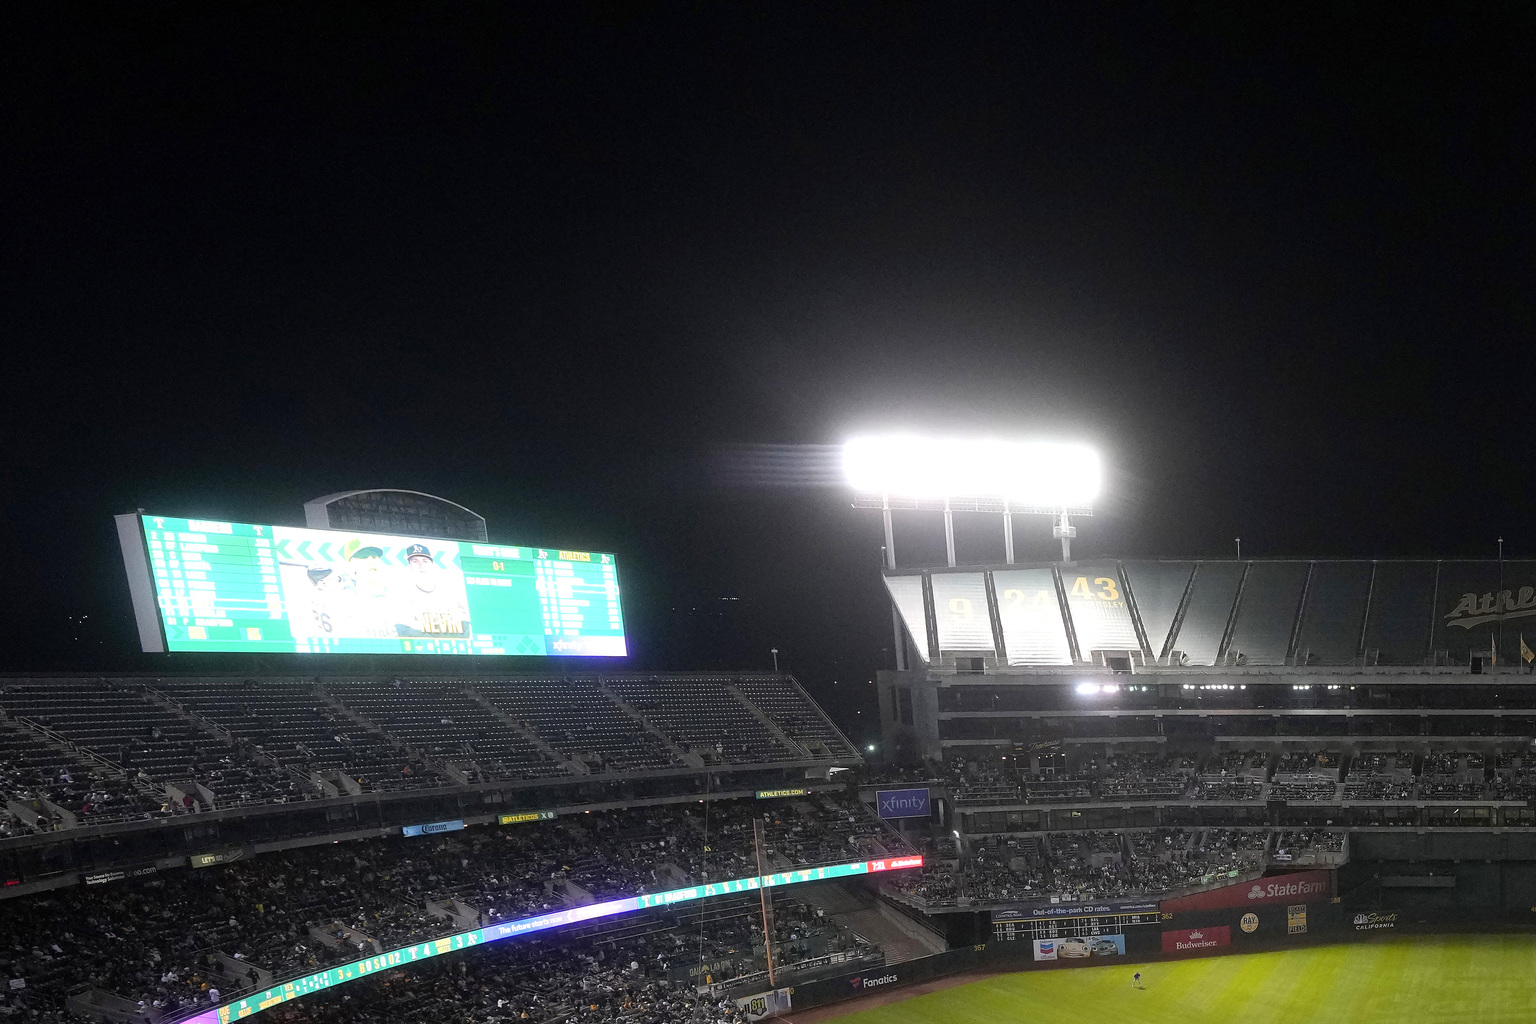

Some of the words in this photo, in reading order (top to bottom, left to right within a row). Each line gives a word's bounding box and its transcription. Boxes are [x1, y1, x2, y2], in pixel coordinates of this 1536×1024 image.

[492, 561, 505, 571] 0-1
[1070, 576, 1119, 601] 43
[420, 612, 464, 634] NEVIN
[759, 788, 804, 797] ATHLETICS.COM
[882, 795, 926, 812] xfinity
[421, 823, 448, 834] Corona
[1033, 907, 1083, 916] Out-of-the-park
[1366, 912, 1398, 923] Sports
[498, 926, 511, 935] The
[511, 923, 531, 933] future
[531, 919, 549, 928] starts
[549, 916, 563, 925] now
[1355, 922, 1394, 930] CALIFORNIA
[456, 936, 463, 948] 3
[1176, 940, 1217, 950] Budweiser
[423, 943, 430, 956] 4
[337, 969, 344, 980] 3
[863, 973, 898, 988] Fanatics
[752, 997, 765, 1010] 811
